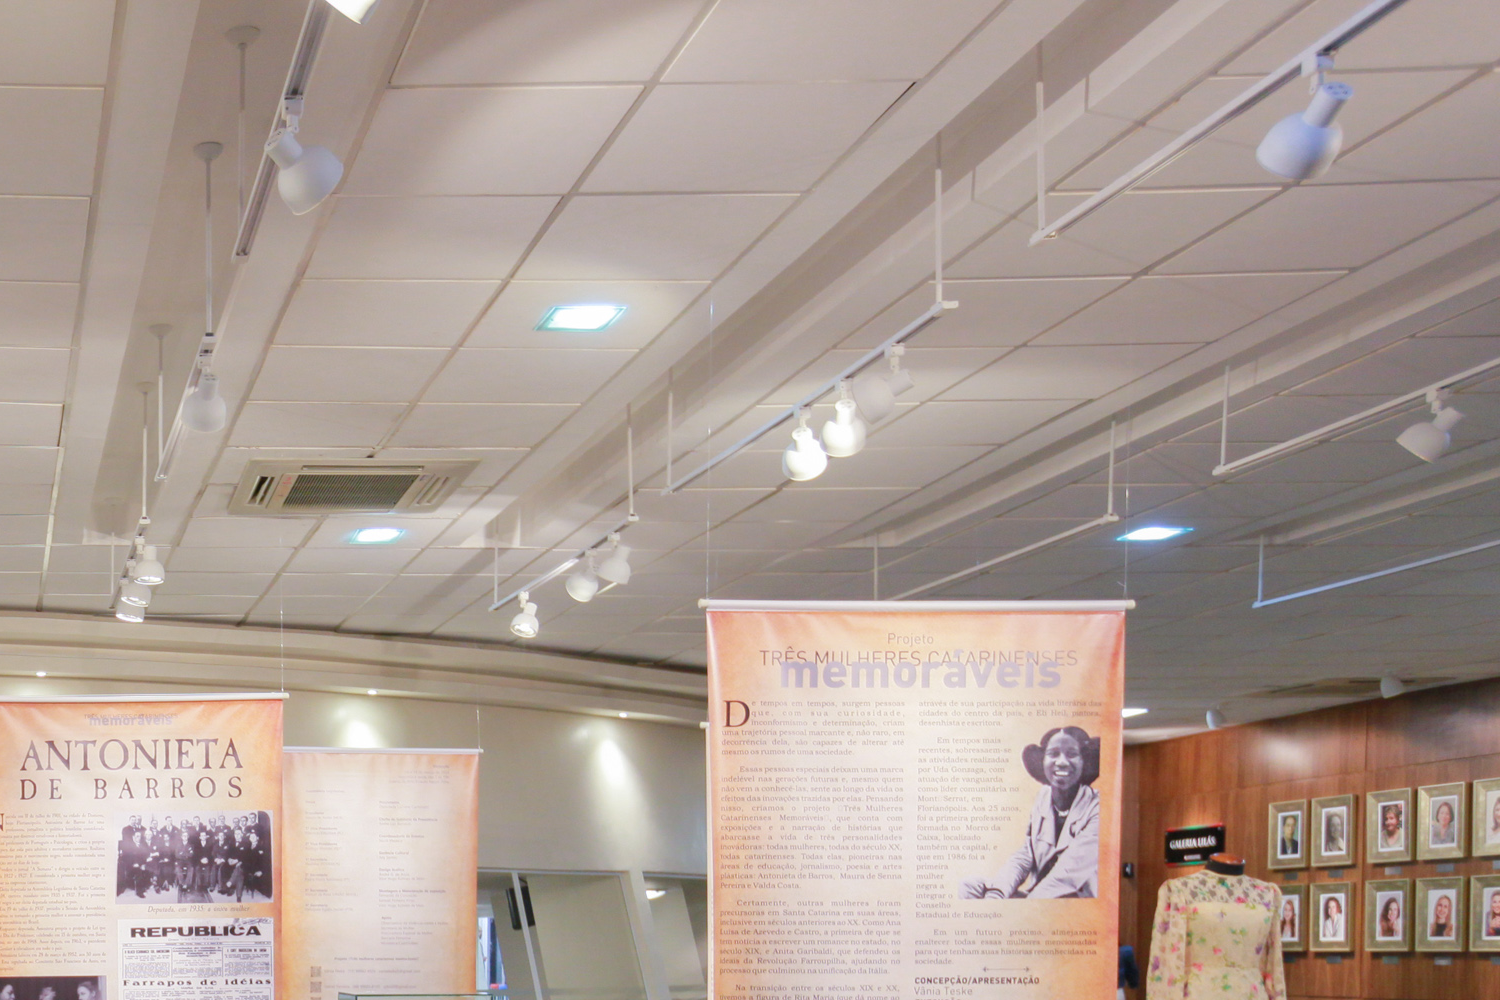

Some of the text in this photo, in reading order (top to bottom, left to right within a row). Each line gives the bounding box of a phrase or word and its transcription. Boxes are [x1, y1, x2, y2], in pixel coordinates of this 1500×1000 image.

[887, 632, 934, 647] Projeto
[760, 646, 807, 666] TRÊS
[814, 650, 921, 666] MULHERES
[780, 649, 1062, 689] memoráveis
[760, 700, 787, 708] tempos
[807, 700, 837, 708] tempos,
[837, 710, 905, 718] curiosidade,
[89, 714, 172, 726] memoráveis
[822, 719, 878, 728] determinação,
[952, 737, 980, 745] tempos
[19, 737, 243, 771] ANTONIETA
[951, 766, 986, 774] Gonzaga,
[918, 776, 949, 784] atuação
[962, 776, 1003, 784] vanguarda
[19, 776, 242, 800] DE BARROS
[918, 805, 969, 813] Florianópolis.
[936, 815, 968, 823] primeira
[970, 815, 1011, 823] professora
[1170, 838, 1197, 849] GALERIA
[916, 863, 948, 871] primeira
[916, 883, 937, 891] negra
[916, 892, 946, 900] integrar
[963, 911, 1003, 920] Educação.
[130, 926, 261, 938] REPUBLICA
[123, 979, 192, 987] Farrapos
[914, 975, 1040, 986] CONCEPÇÃO/APRESENTAÇÃO
[914, 986, 973, 995] Vânia Teske
